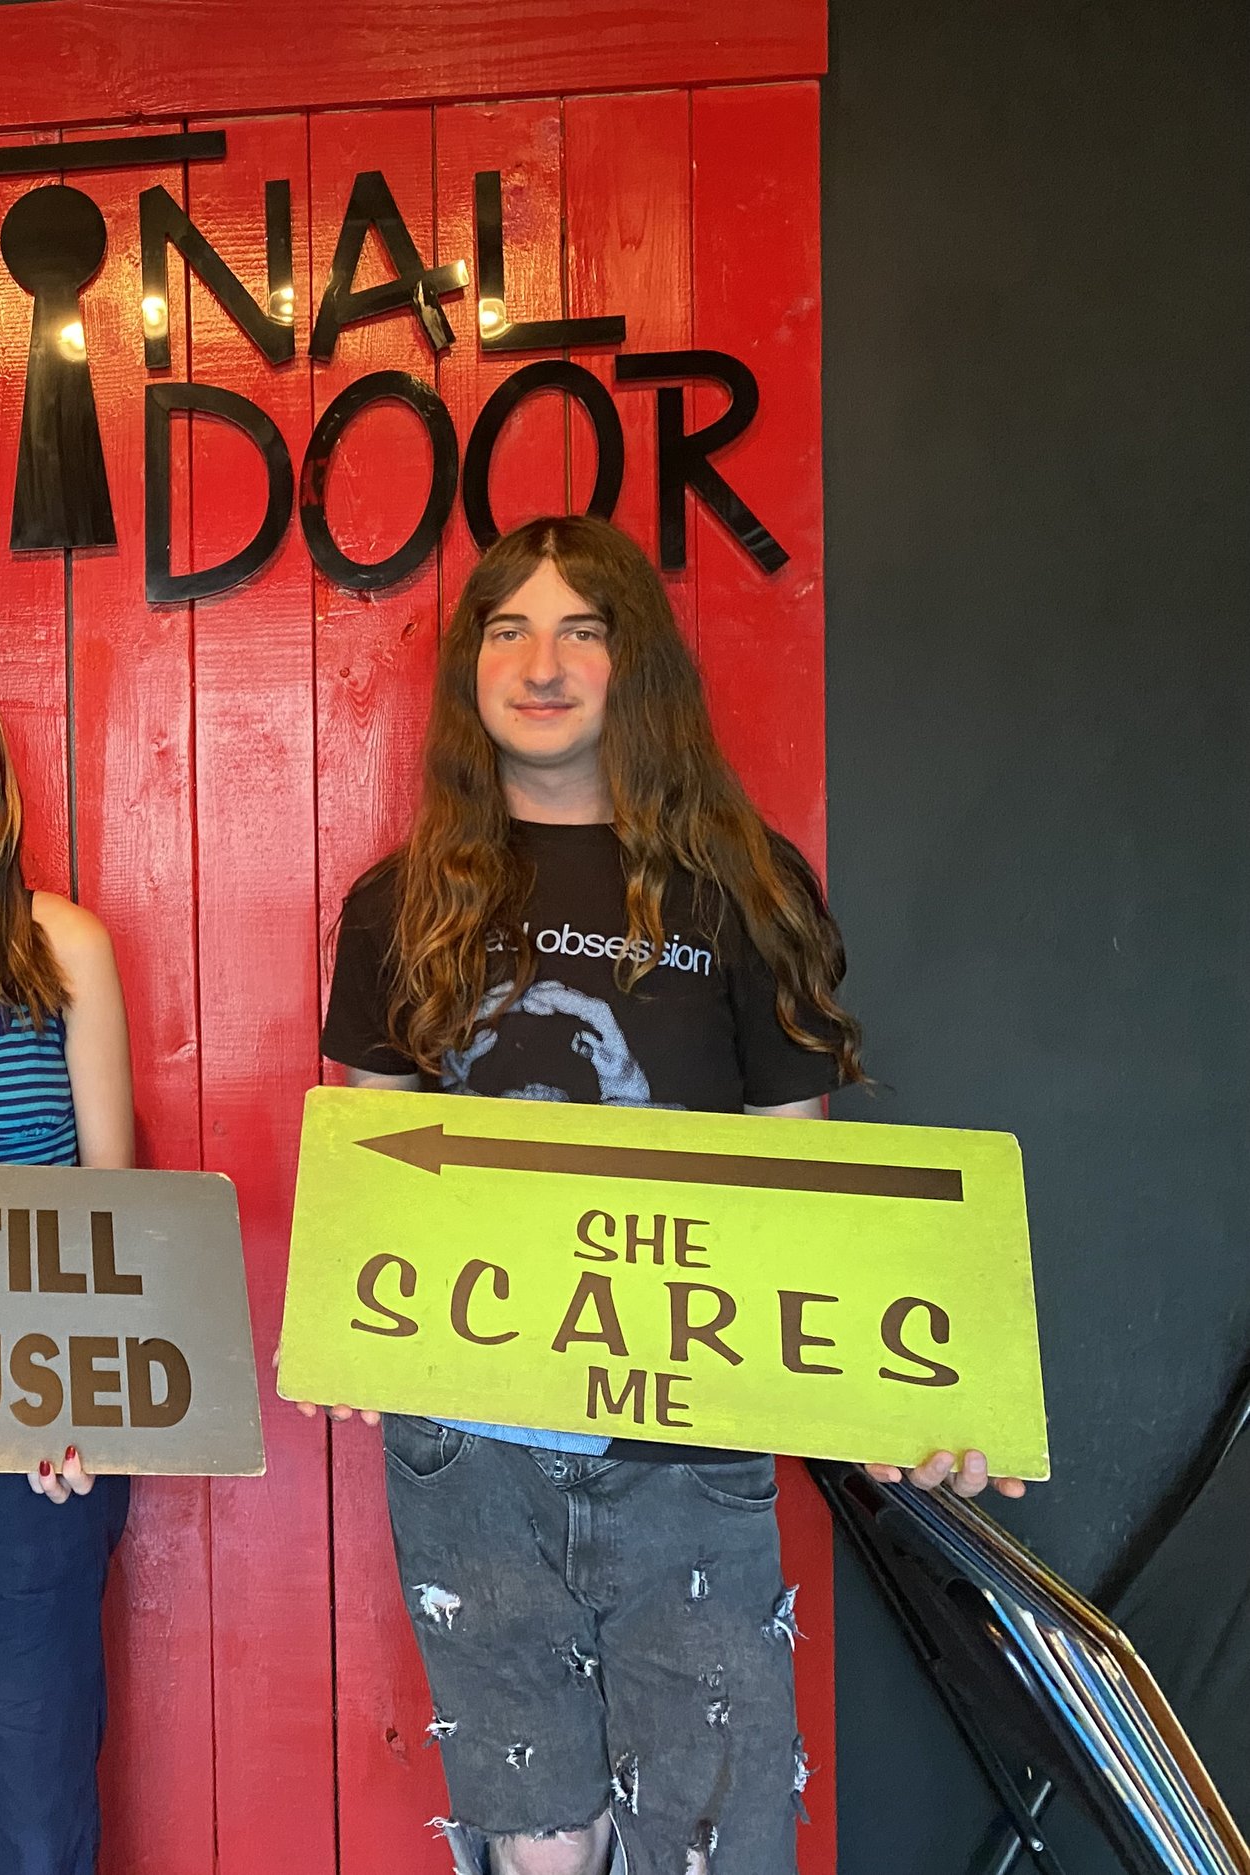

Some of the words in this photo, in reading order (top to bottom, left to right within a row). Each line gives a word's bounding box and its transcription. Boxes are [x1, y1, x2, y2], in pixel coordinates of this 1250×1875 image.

[144, 349, 791, 602] DOOR
[574, 1208, 712, 1268] SHE
[350, 1252, 960, 1388] SCARES
[586, 1366, 694, 1428] ME
